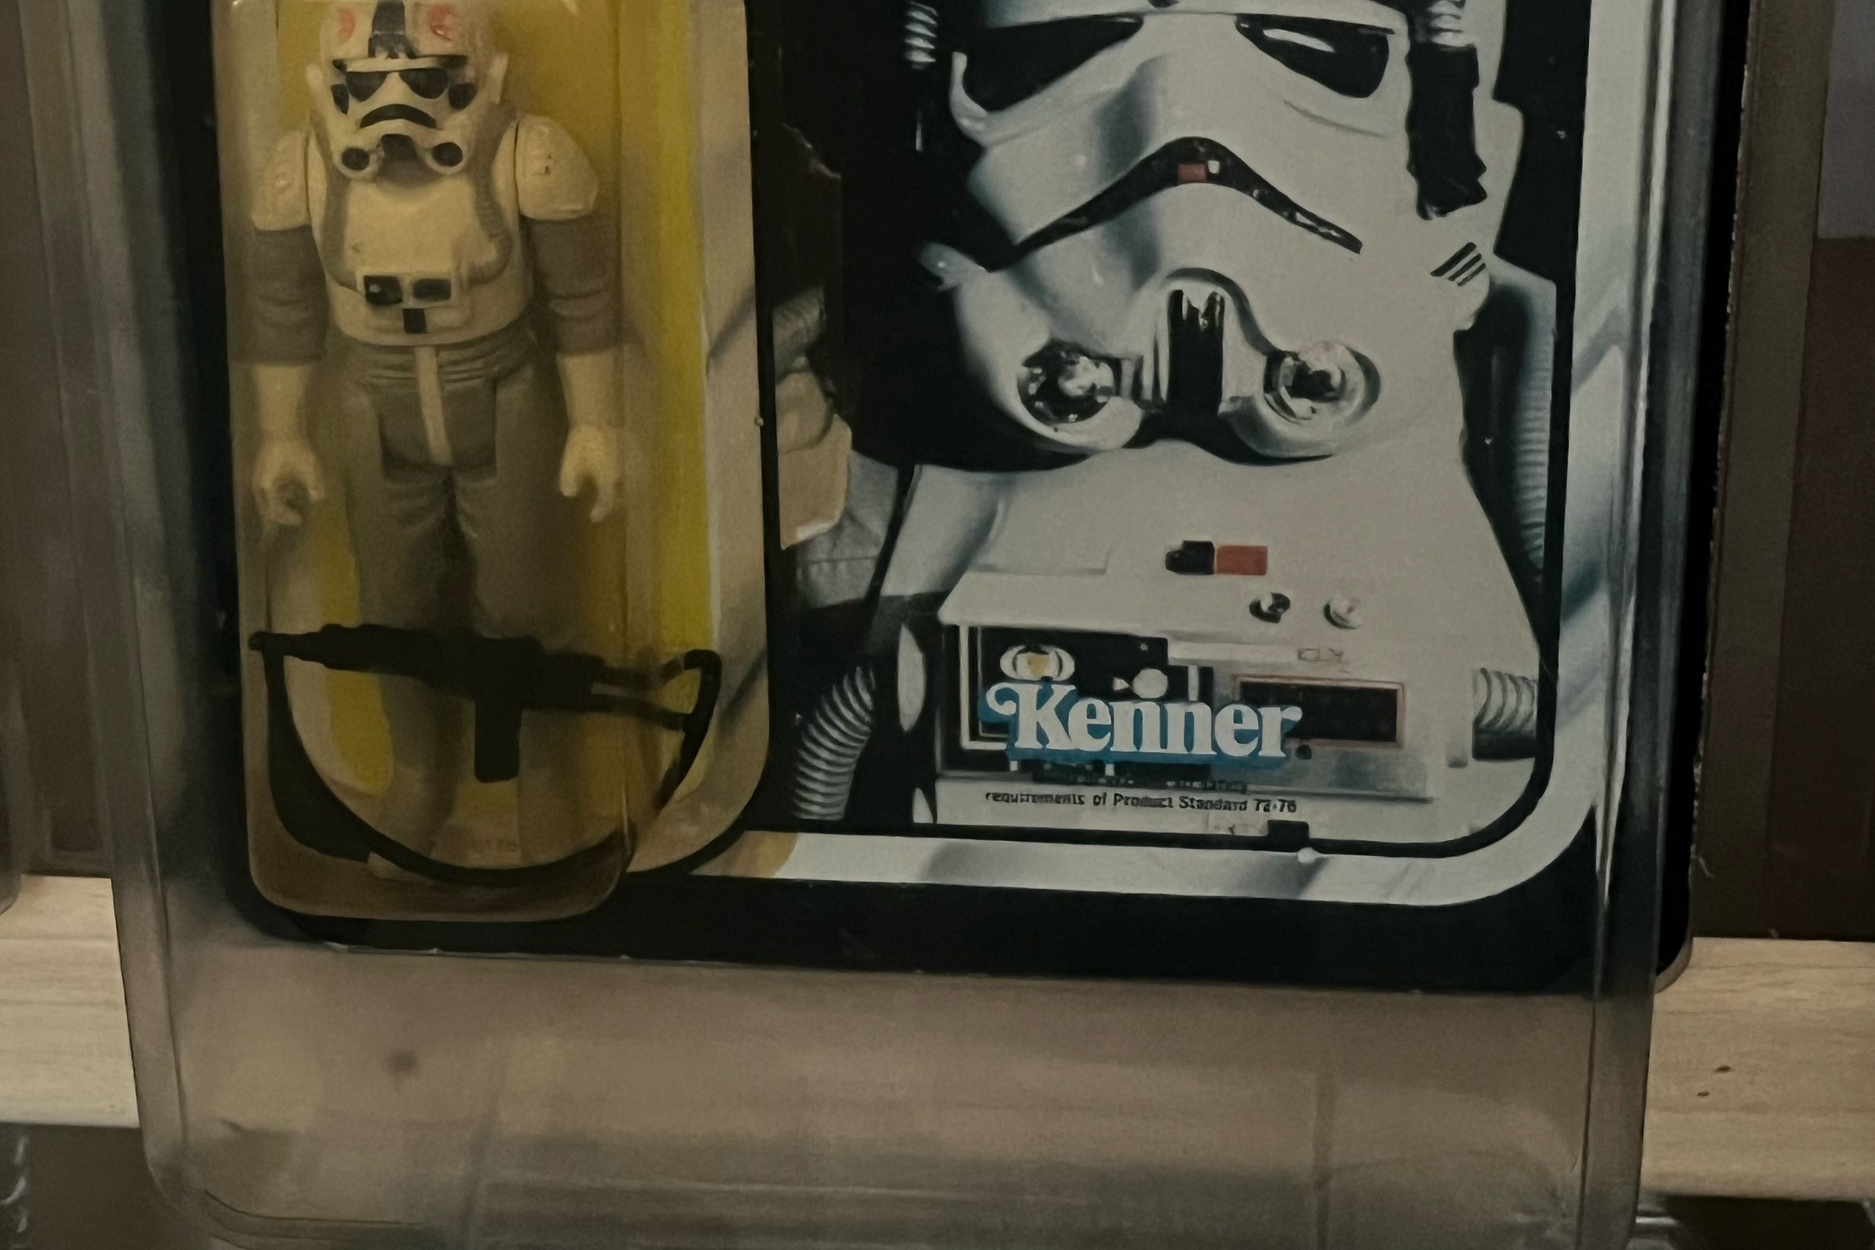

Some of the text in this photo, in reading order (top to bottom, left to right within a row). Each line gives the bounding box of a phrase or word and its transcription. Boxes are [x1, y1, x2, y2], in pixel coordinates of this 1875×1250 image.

[983, 681, 1303, 764] Kenner
[985, 790, 1086, 807] requirements
[1092, 791, 1108, 807] of
[1113, 792, 1174, 810] Product
[1178, 794, 1249, 813] Standard
